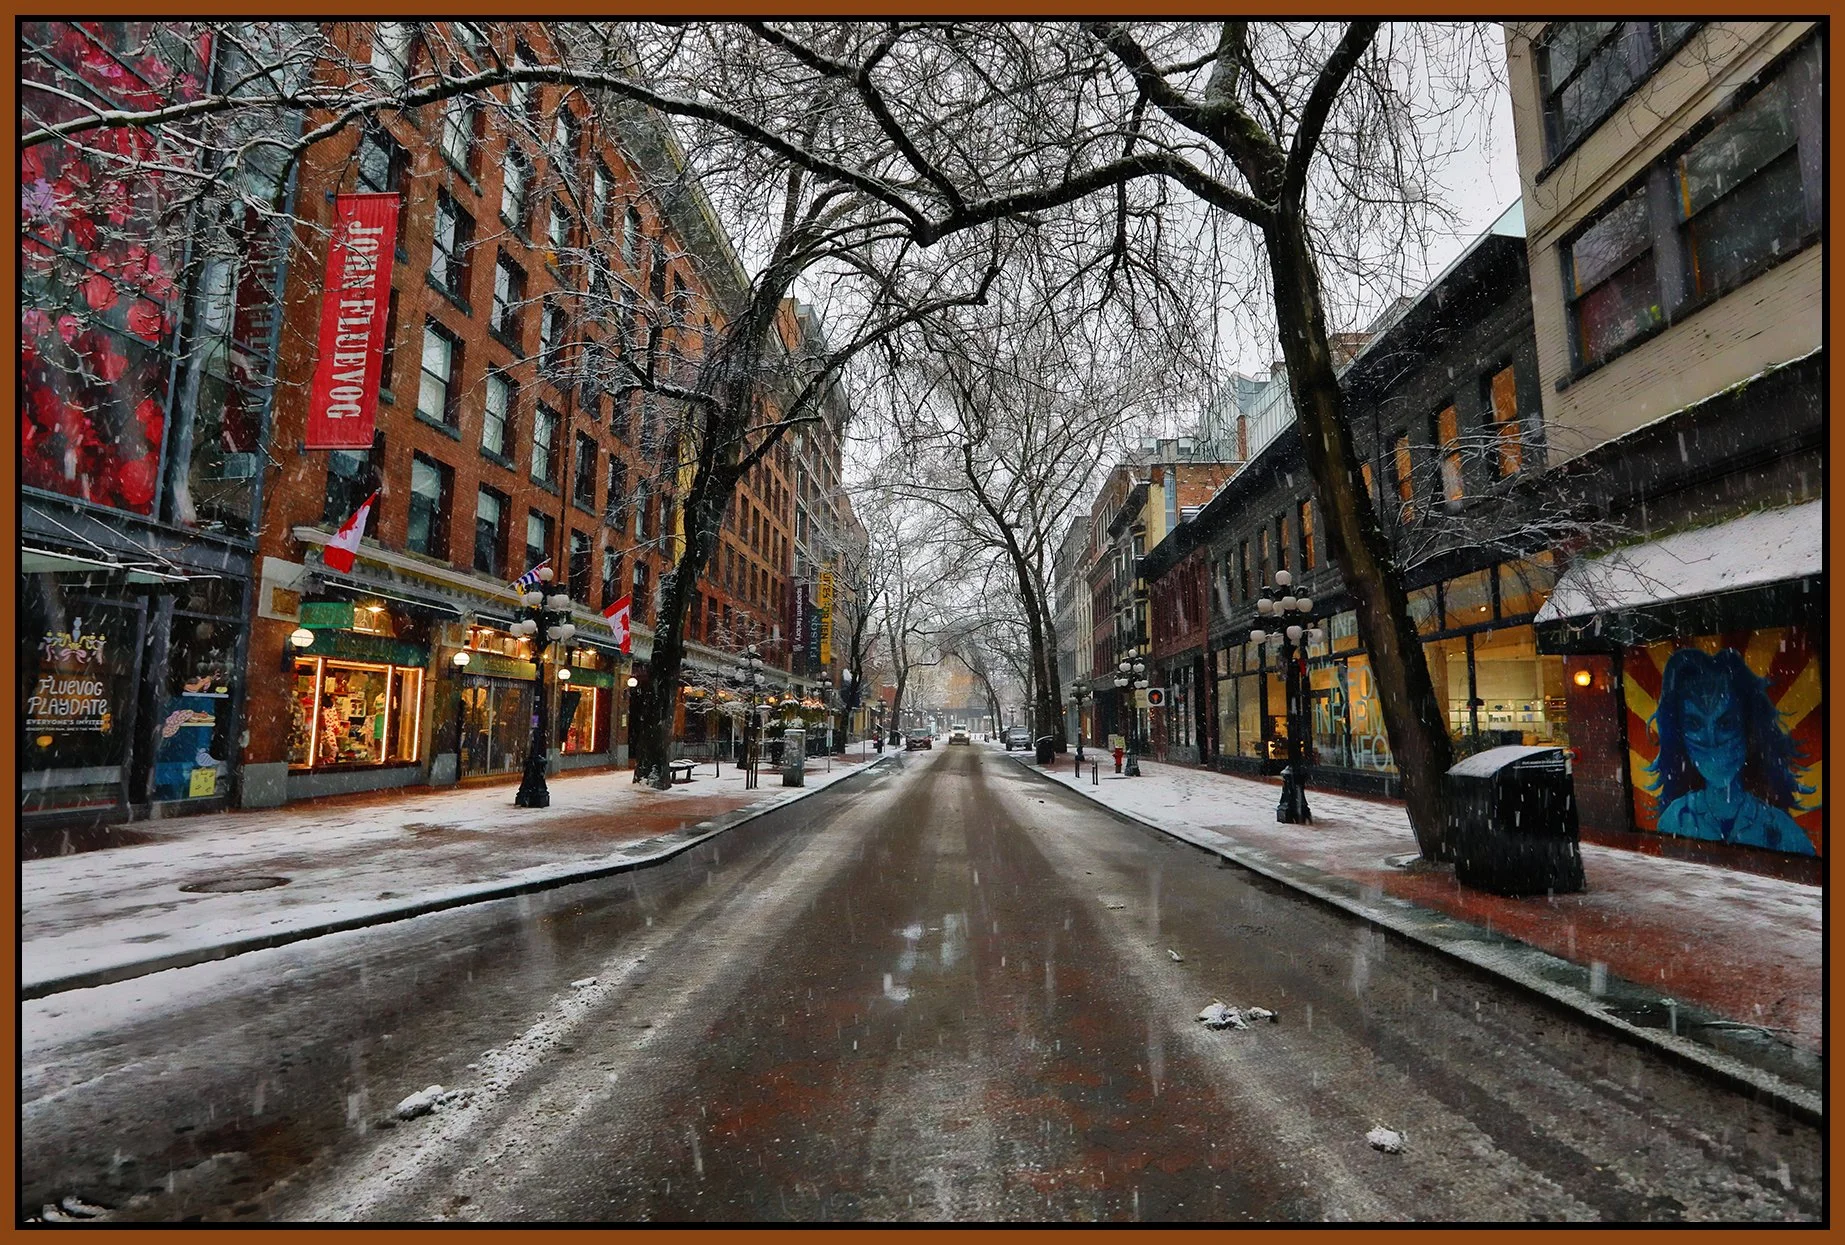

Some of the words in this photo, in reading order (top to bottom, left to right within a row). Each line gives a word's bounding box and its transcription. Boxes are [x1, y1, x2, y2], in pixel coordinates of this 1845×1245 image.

[341, 220, 384, 290] JOHN
[326, 298, 376, 419] FLUEVOG
[795, 617, 803, 641] factory
[810, 615, 818, 658] FILSON
